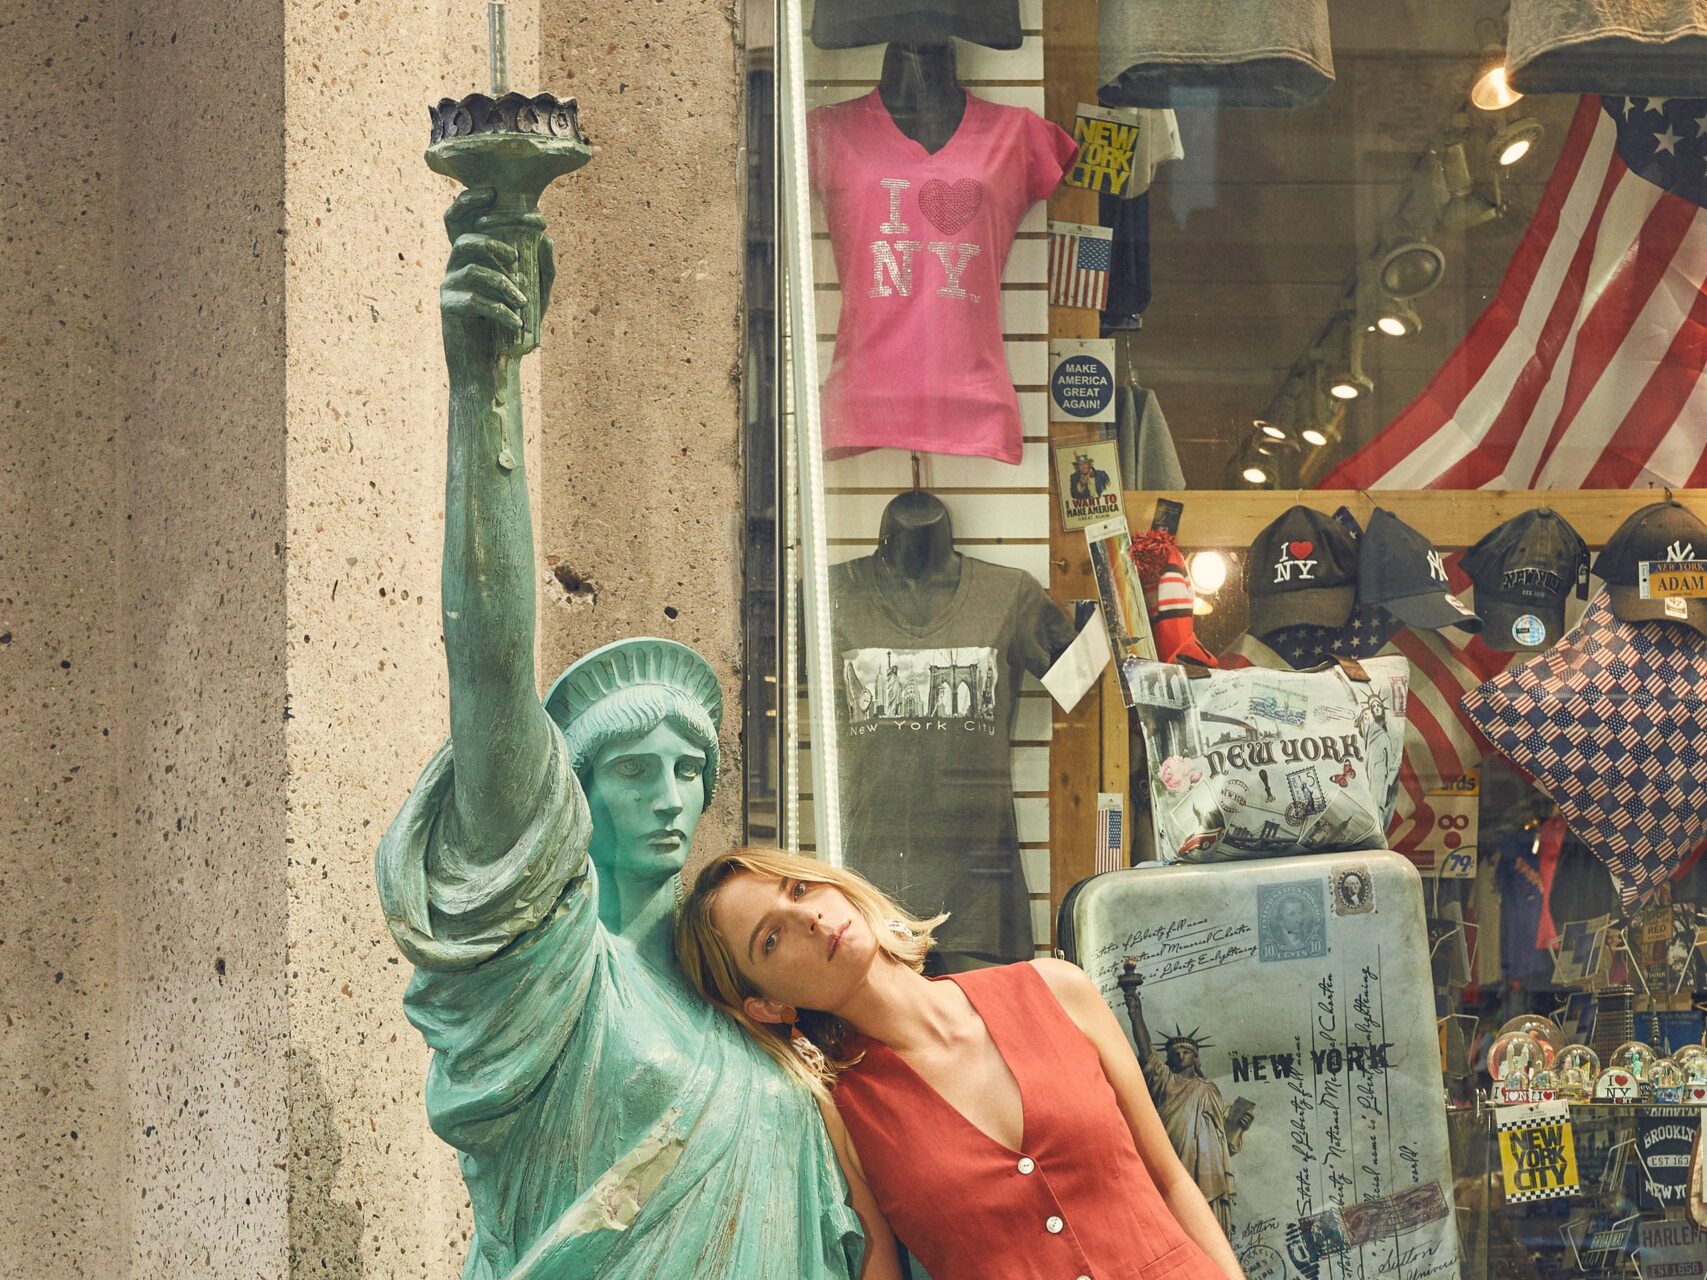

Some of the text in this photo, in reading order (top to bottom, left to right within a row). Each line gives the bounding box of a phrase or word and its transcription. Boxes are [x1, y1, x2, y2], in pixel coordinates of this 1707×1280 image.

[1074, 117, 1139, 151] NEW
[880, 178, 910, 234] I
[1065, 363, 1097, 374] MAKE
[1057, 375, 1108, 386] AMERICA
[1063, 387, 1100, 397] GREAT
[1062, 399, 1101, 409] AGAIN!
[1072, 496, 1101, 508] WANT
[1103, 493, 1118, 505] TO
[1066, 503, 1119, 518] MAKE AMERICA
[1279, 542, 1289, 562] I
[1273, 560, 1318, 583] NY
[1679, 562, 1704, 572] YORK
[1658, 576, 1704, 592] ADAM
[850, 722, 878, 736] New
[894, 720, 948, 731] York
[1264, 943, 1276, 959] 10
[1310, 939, 1323, 954] 10
[1232, 1043, 1395, 1083] NEW YORK
[1607, 1075, 1615, 1086] I
[1494, 1086, 1500, 1099] I
[1605, 1087, 1632, 1097] NY
[1686, 1089, 1693, 1099] I
[1509, 1126, 1563, 1153] NEW
[1643, 1124, 1696, 1149] BROOKLY
[1512, 1145, 1568, 1169] YORK
[1651, 1157, 1671, 1166] EST
[1514, 1163, 1568, 1191] CITY
[1645, 1180, 1672, 1199] NEW
